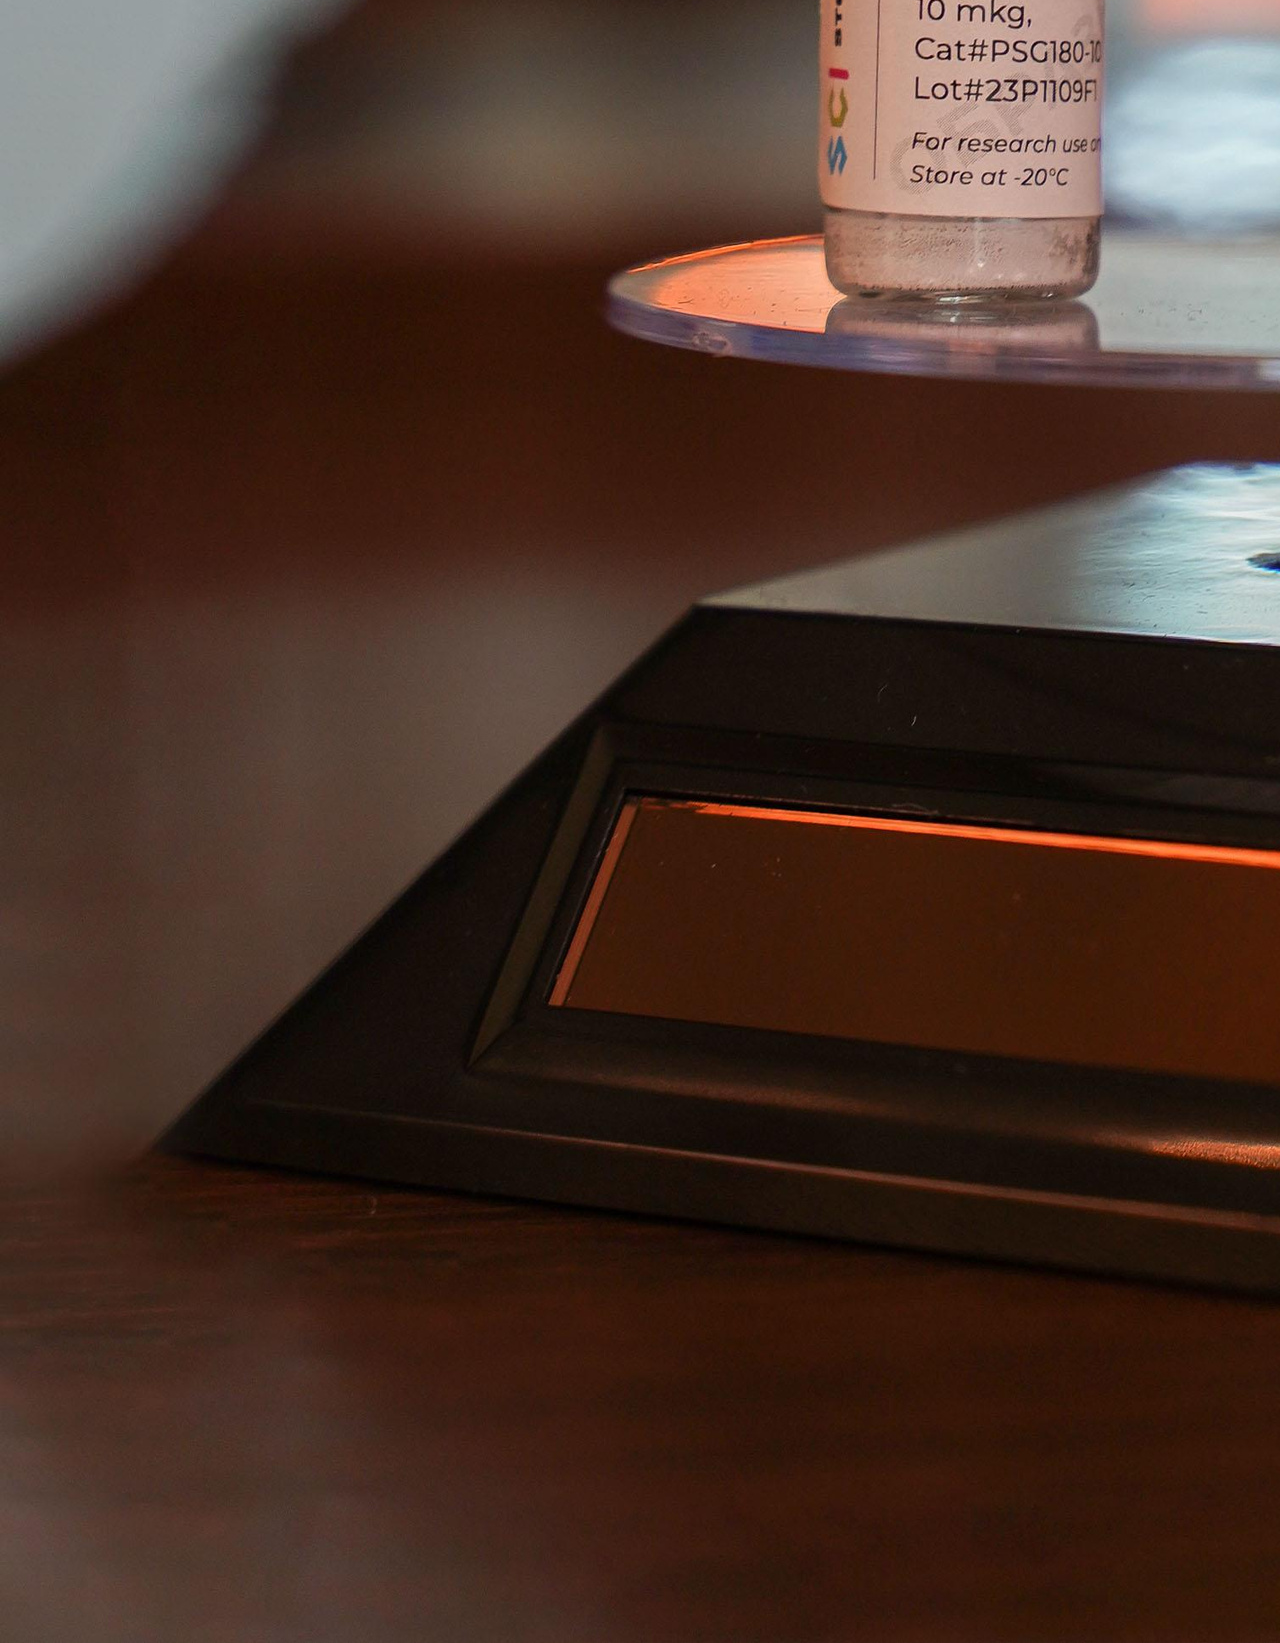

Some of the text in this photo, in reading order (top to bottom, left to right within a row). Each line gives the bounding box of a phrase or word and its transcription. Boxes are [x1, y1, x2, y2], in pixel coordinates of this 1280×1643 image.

[956, 0, 1033, 29] mkg,
[914, 37, 1102, 64] Cat#PSG180-10
[913, 76, 1098, 103] Lot#23P1109F1
[911, 131, 952, 152] For
[956, 134, 1056, 154] research
[1061, 138, 1088, 153] use
[909, 165, 974, 186] Store
[980, 168, 1007, 186] at
